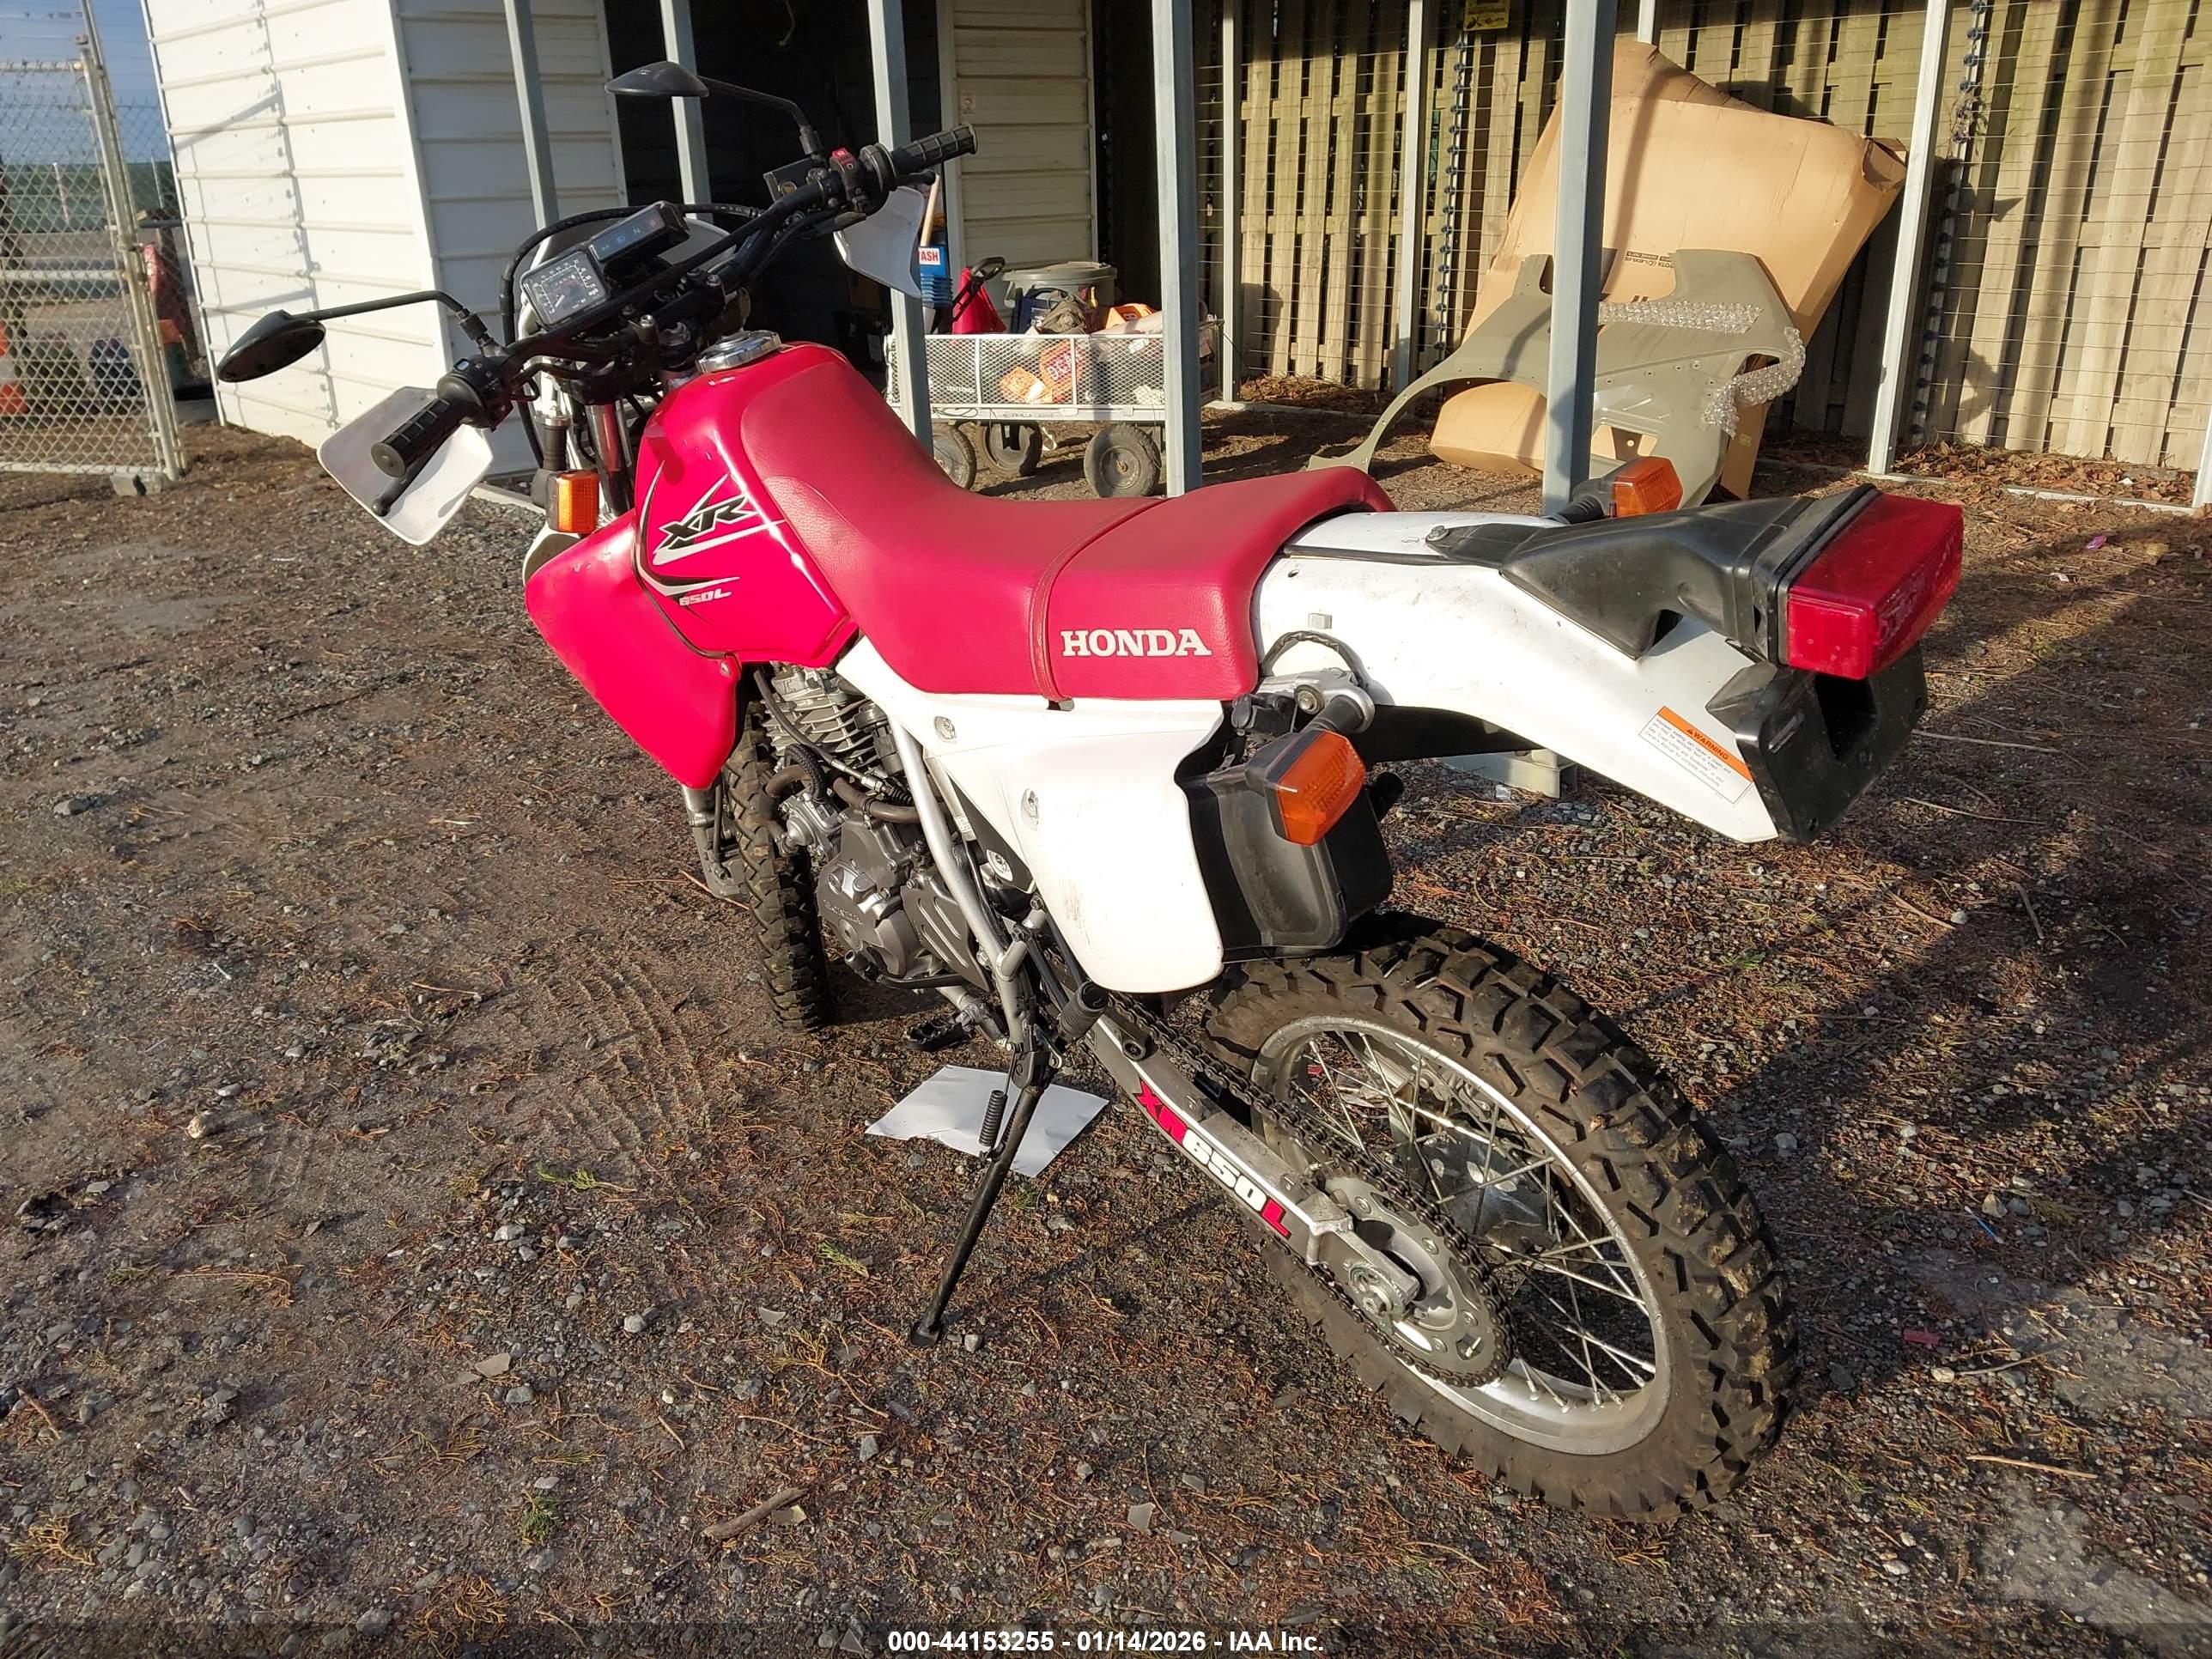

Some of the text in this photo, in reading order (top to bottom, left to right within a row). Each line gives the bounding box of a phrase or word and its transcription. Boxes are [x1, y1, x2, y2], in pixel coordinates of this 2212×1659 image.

[921, 251, 939, 262] ASH
[653, 481, 760, 555] XR
[679, 587, 732, 606] 650L
[1060, 629, 1212, 657] HONDA
[1693, 731, 1729, 761] WARNING
[1133, 1075, 1291, 1238] XR650L
